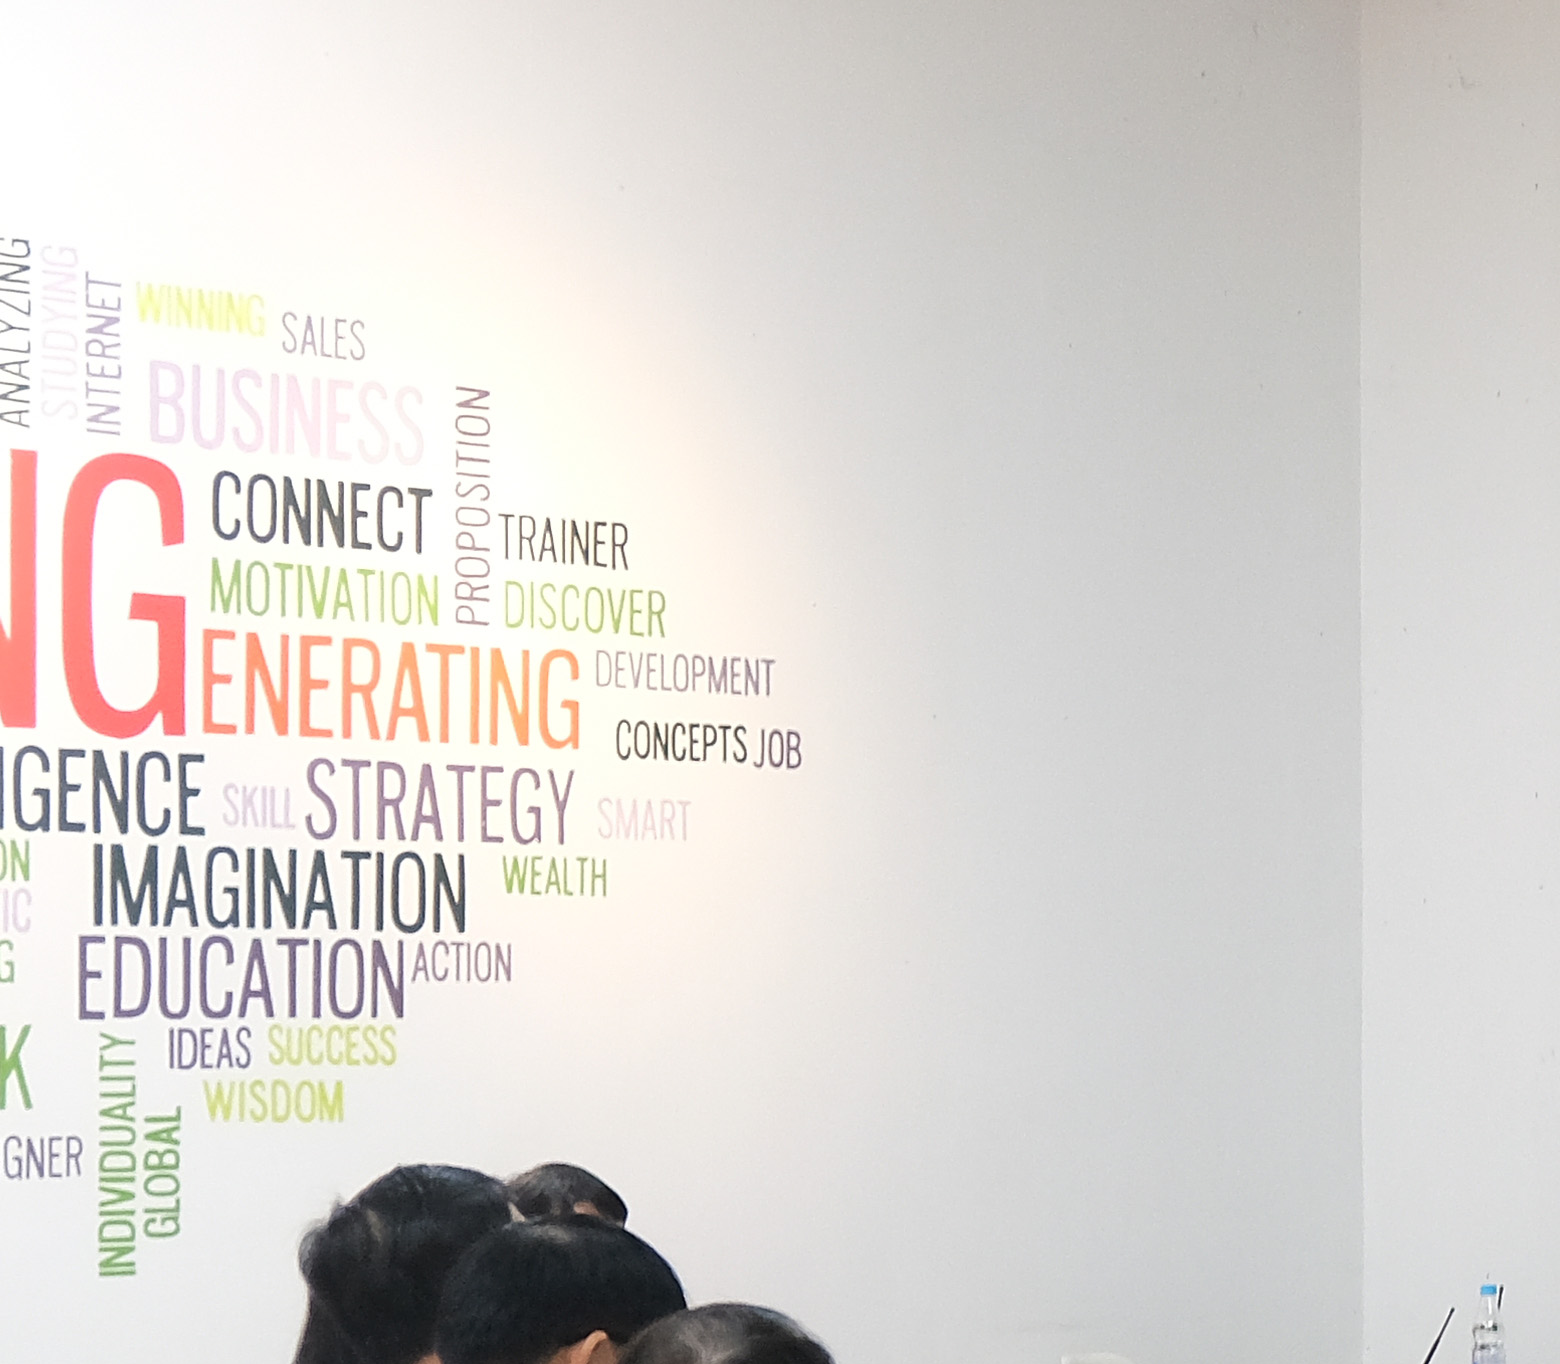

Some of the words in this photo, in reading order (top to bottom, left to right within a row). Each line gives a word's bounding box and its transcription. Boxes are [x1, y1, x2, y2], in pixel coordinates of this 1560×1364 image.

[0, 237, 31, 429] ANALYZING
[40, 245, 79, 420] STUDYING
[135, 281, 266, 337] WINNING
[281, 310, 367, 361] SALES
[85, 270, 123, 436] INTERNET
[149, 359, 425, 466] BUSINESS
[211, 468, 434, 555] CONNECT
[454, 385, 492, 627] PROPOSITION
[498, 512, 630, 571] TRAINER
[209, 556, 440, 628] MOTIVATION
[503, 579, 668, 639] DISCOVER
[201, 628, 582, 751] ENERATING
[594, 648, 777, 698] DEVELOPMENT
[615, 718, 750, 766] CONCEPTS
[752, 726, 803, 771] JOB
[221, 782, 297, 830] SKILL
[305, 757, 577, 847] STRATEGY
[597, 796, 693, 843] SMART
[92, 843, 468, 934] IMAGINATION
[501, 855, 609, 899] WEALTH
[78, 934, 405, 1022] EDUCATION
[410, 940, 514, 985] ACTION
[167, 1025, 253, 1071] IDEAS
[266, 1023, 399, 1068] SUCCESS
[203, 1078, 346, 1125] WISDOM
[3, 1135, 84, 1181] GNER
[97, 1031, 138, 1279] INDIVIDUALITY
[142, 1104, 183, 1240] GLOBAL
